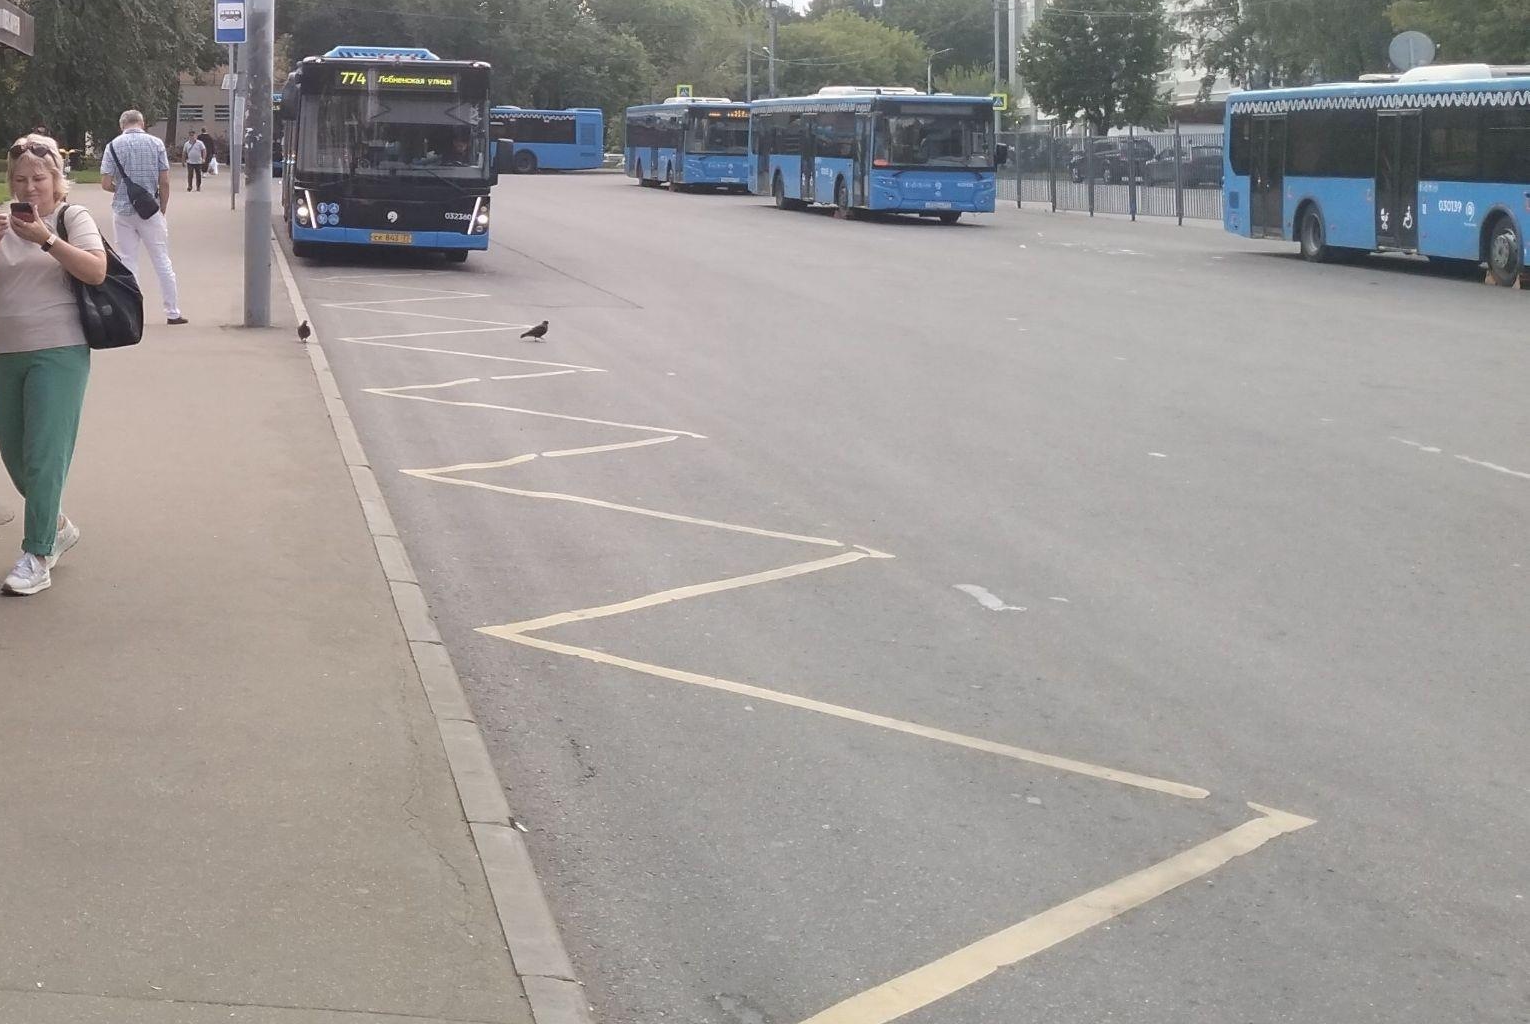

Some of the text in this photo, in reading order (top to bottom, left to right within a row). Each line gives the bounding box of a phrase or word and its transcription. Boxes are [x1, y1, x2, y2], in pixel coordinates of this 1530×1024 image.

[340, 72, 452, 86] 774 Лобненская улица
